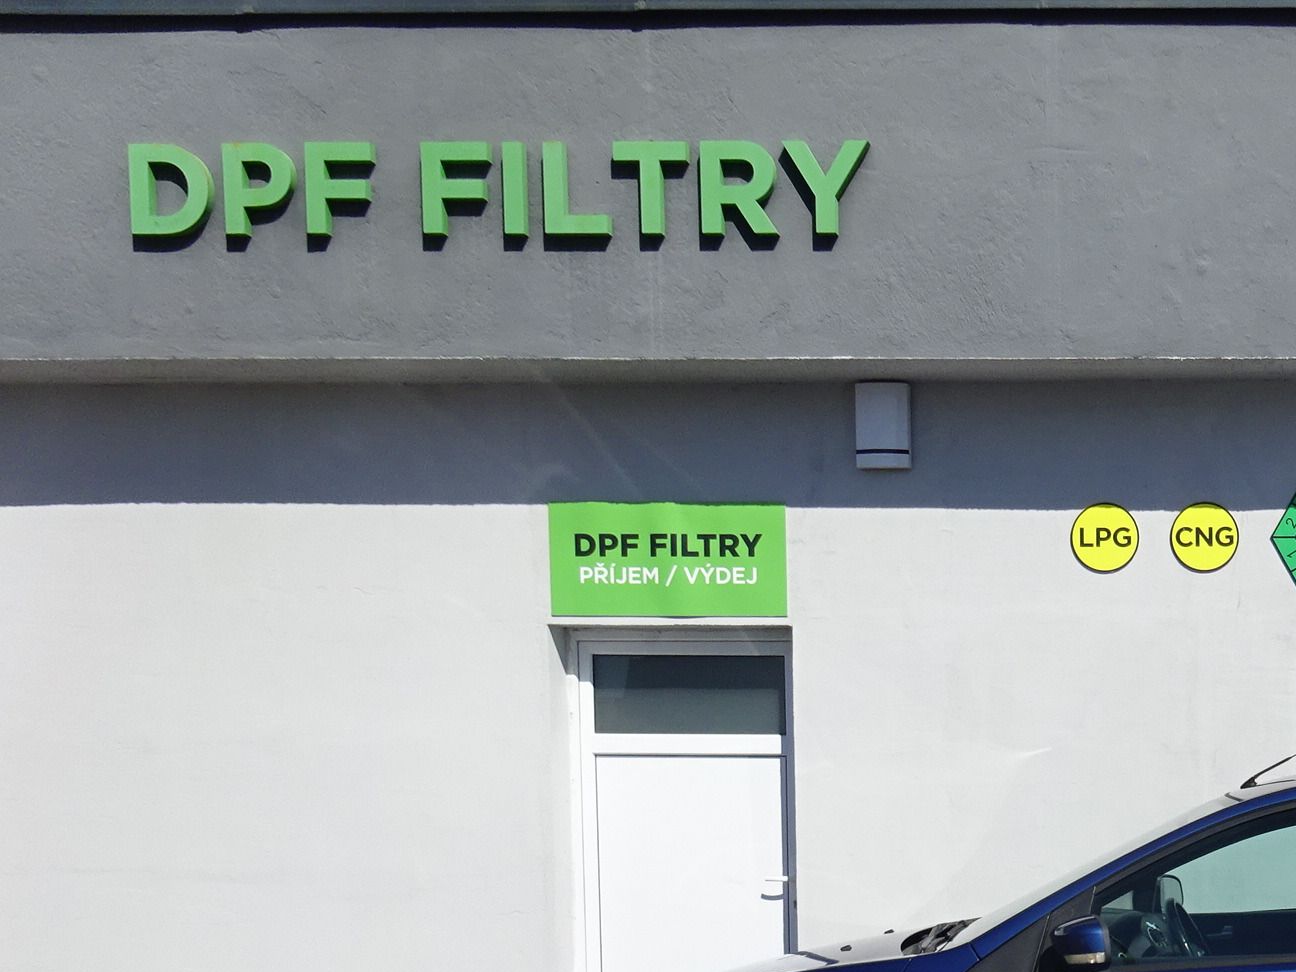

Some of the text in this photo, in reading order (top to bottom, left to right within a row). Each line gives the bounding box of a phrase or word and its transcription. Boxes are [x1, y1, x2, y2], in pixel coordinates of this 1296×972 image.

[128, 140, 870, 237] DPF FILTRY
[574, 533, 762, 557] DPF FILTRY
[1079, 526, 1132, 548] LPG
[1175, 526, 1235, 548] CNG
[579, 562, 758, 587] PŘÍJEM / VÝDEJ
